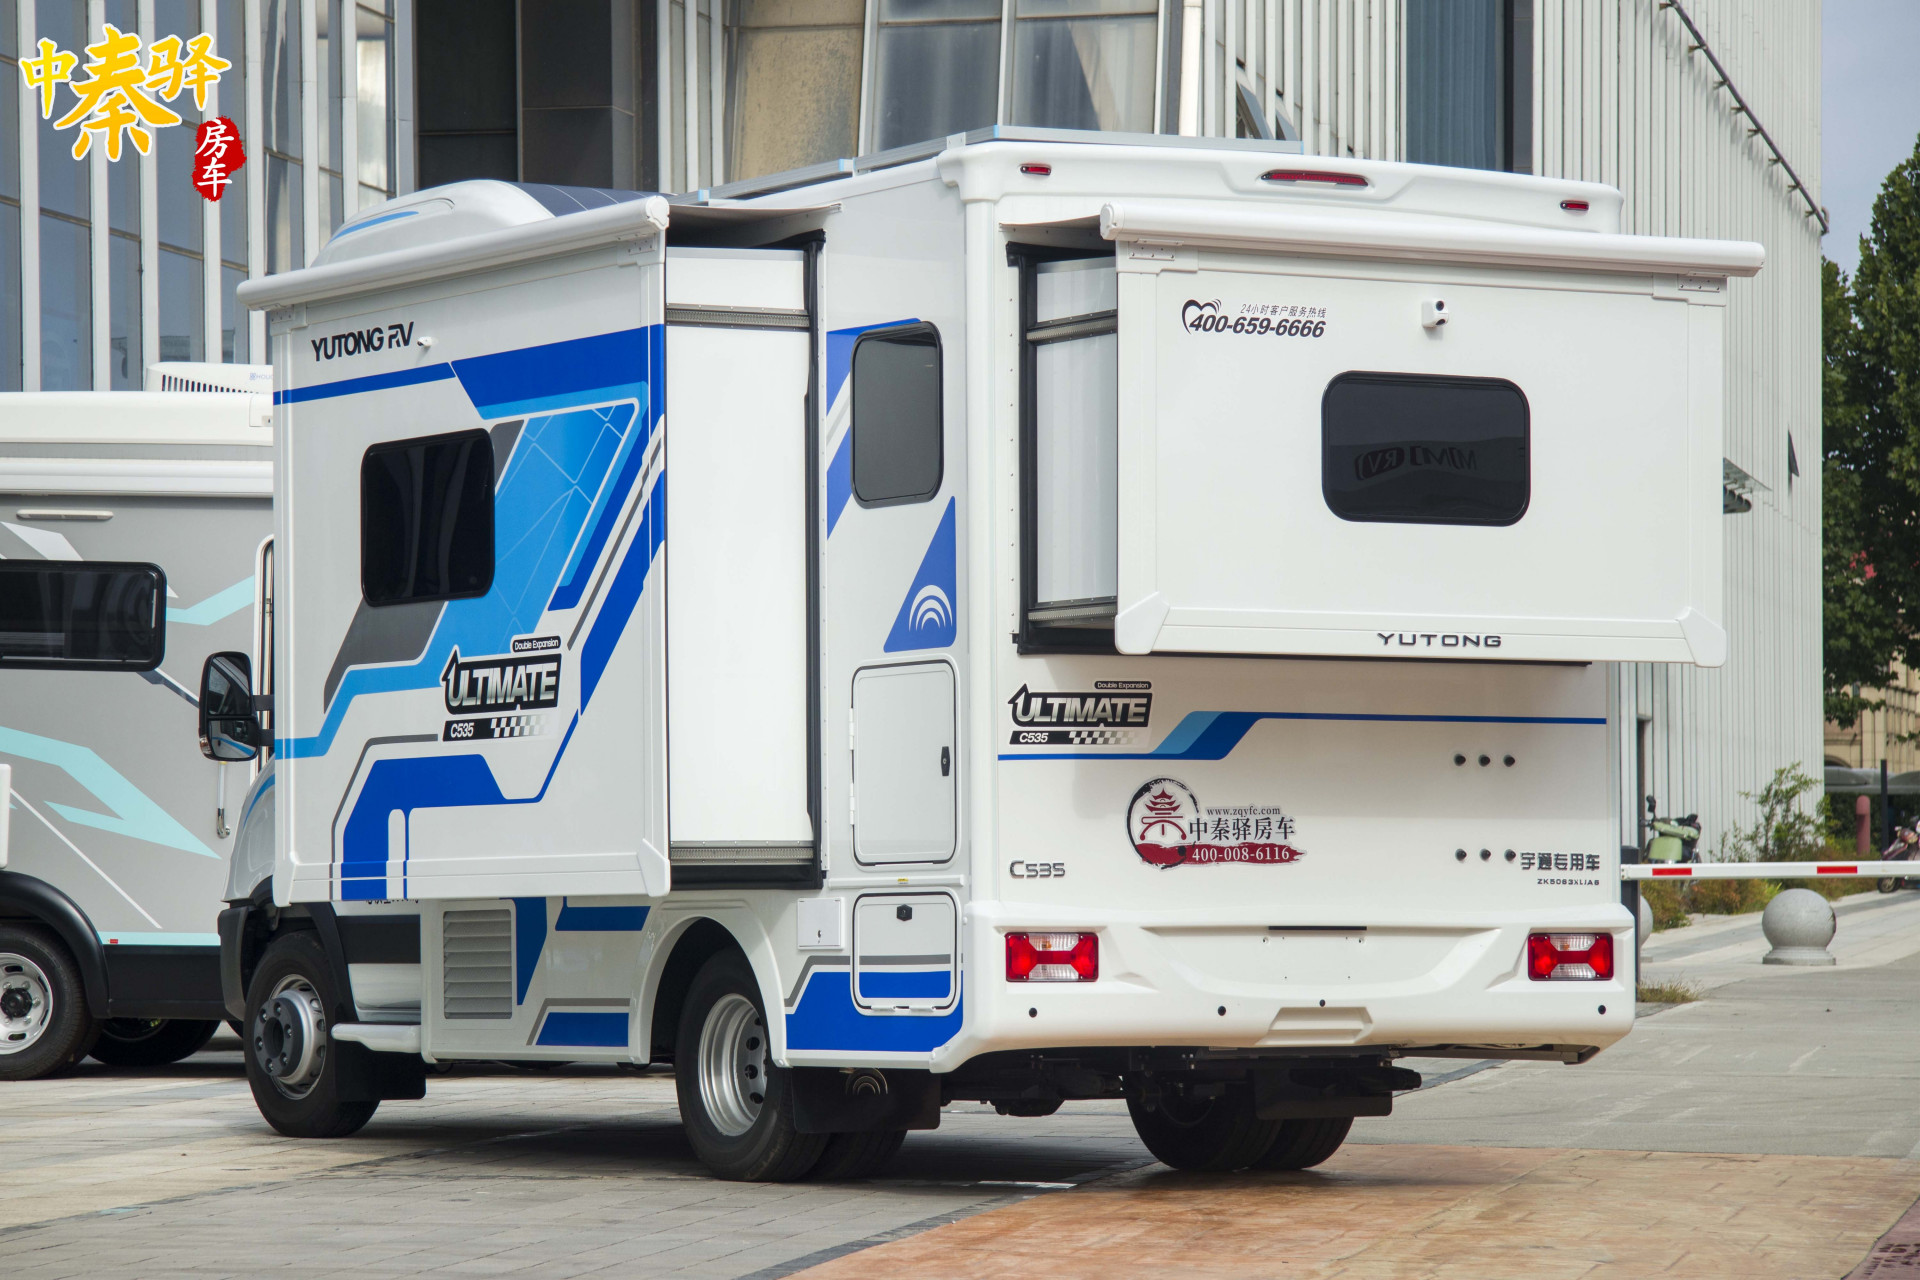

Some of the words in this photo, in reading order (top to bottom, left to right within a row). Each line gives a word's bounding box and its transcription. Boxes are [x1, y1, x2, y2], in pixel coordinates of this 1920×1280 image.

[1240, 303, 1327, 318] 24小时客户服务热线
[1189, 314, 1326, 338] 400-659-6666
[311, 327, 384, 361] YUTONG
[388, 321, 414, 349] RV
[514, 641, 532, 650] Double
[533, 638, 559, 650] Expansion
[1377, 633, 1502, 647] YUTONG
[447, 662, 558, 707] ULTIMATE
[1119, 682, 1148, 690] Expansion
[1015, 692, 1148, 722] ULTIMATE
[450, 722, 474, 738] C535
[1019, 733, 1049, 743] C535
[1206, 806, 1281, 817] www.zqyfc.com
[1189, 817, 1295, 841] 中秦驿房车
[1192, 847, 1290, 861] 400-008-6116
[1520, 852, 1600, 871] 宇通专用车
[1010, 860, 1065, 879] C535
